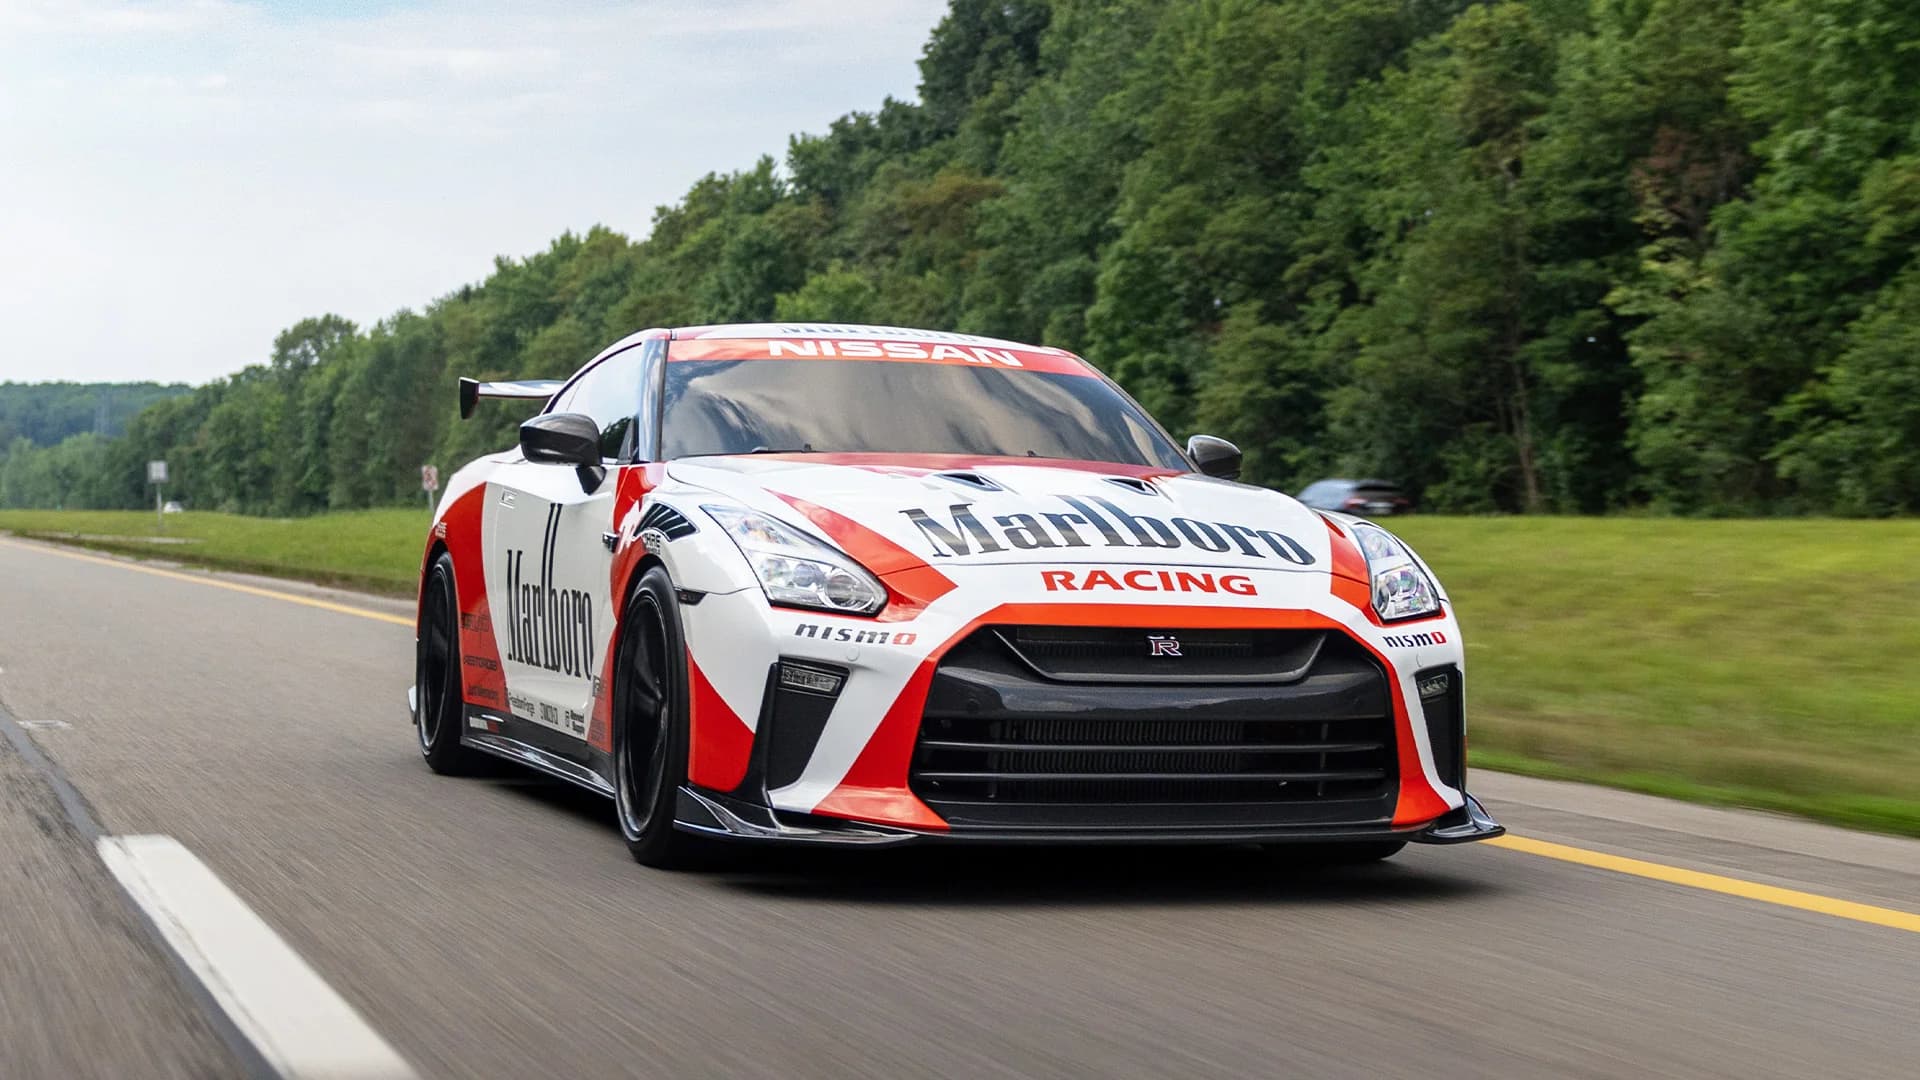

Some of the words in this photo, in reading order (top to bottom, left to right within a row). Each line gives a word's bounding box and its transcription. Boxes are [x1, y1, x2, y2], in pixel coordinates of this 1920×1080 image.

[768, 340, 1023, 367] NISSAN
[899, 495, 1315, 565] Marlboro
[507, 503, 594, 680] Marlboro
[1041, 570, 1258, 596] RACING
[795, 624, 917, 646] nismo
[1383, 631, 1447, 648] nismo
